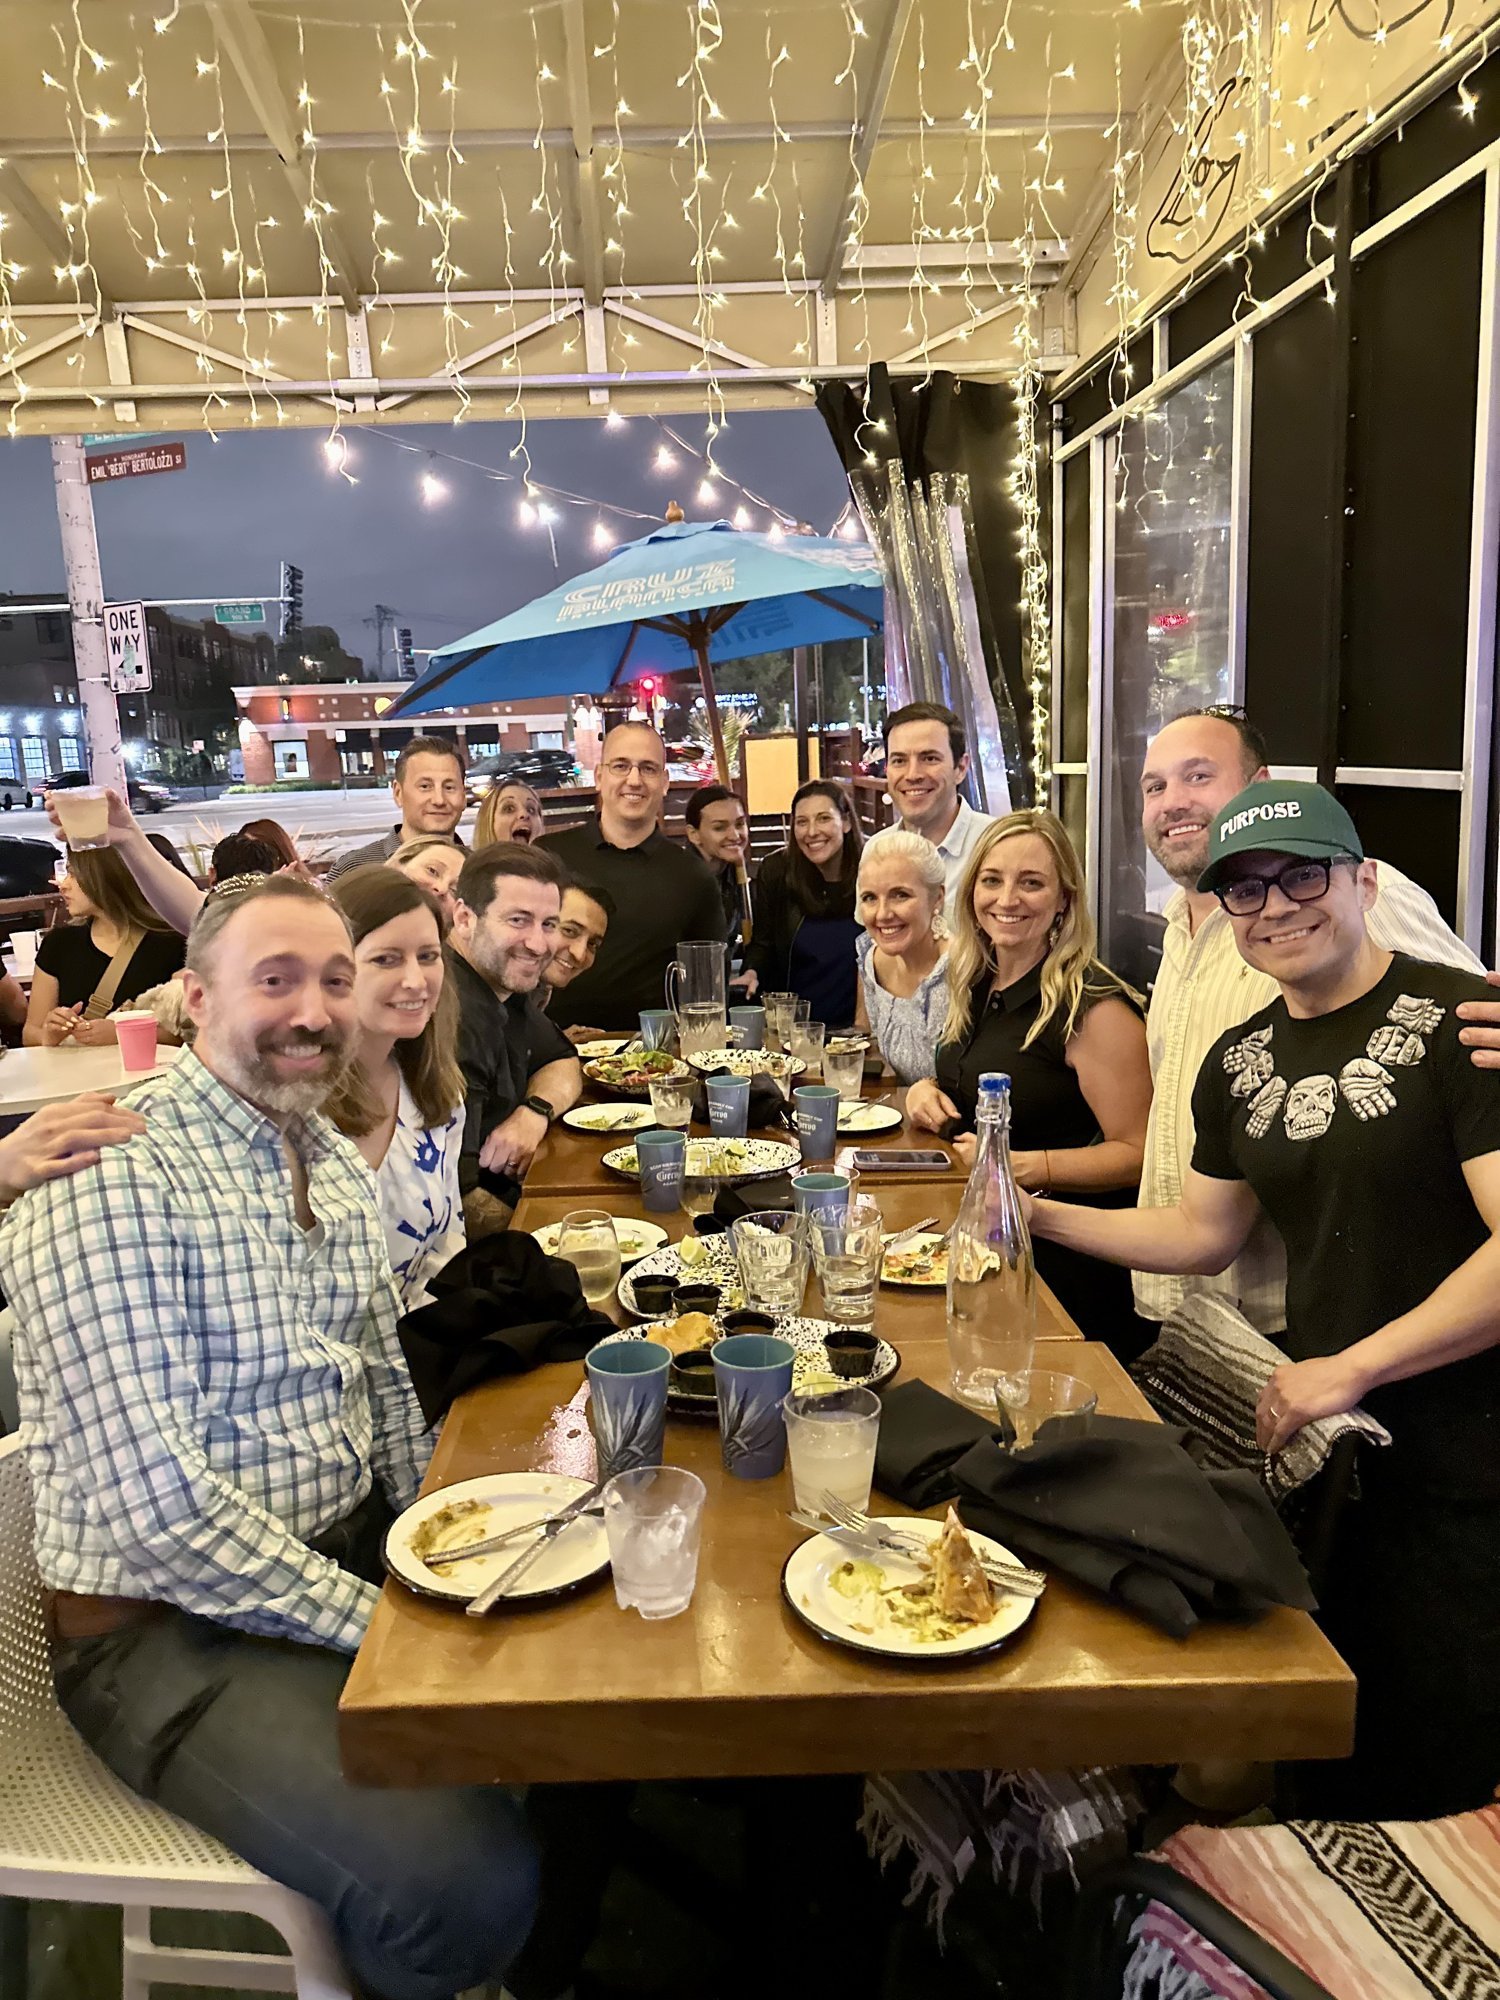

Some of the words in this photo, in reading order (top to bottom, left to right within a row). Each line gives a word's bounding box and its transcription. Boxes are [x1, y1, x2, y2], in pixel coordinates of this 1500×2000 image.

[91, 465, 107, 480] EMIL
[131, 454, 173, 473] BERTOLOZZI
[564, 558, 736, 604] CRUZ
[109, 610, 138, 631] ONE
[110, 633, 140, 655] WAY
[1220, 801, 1302, 842] PURPOSE
